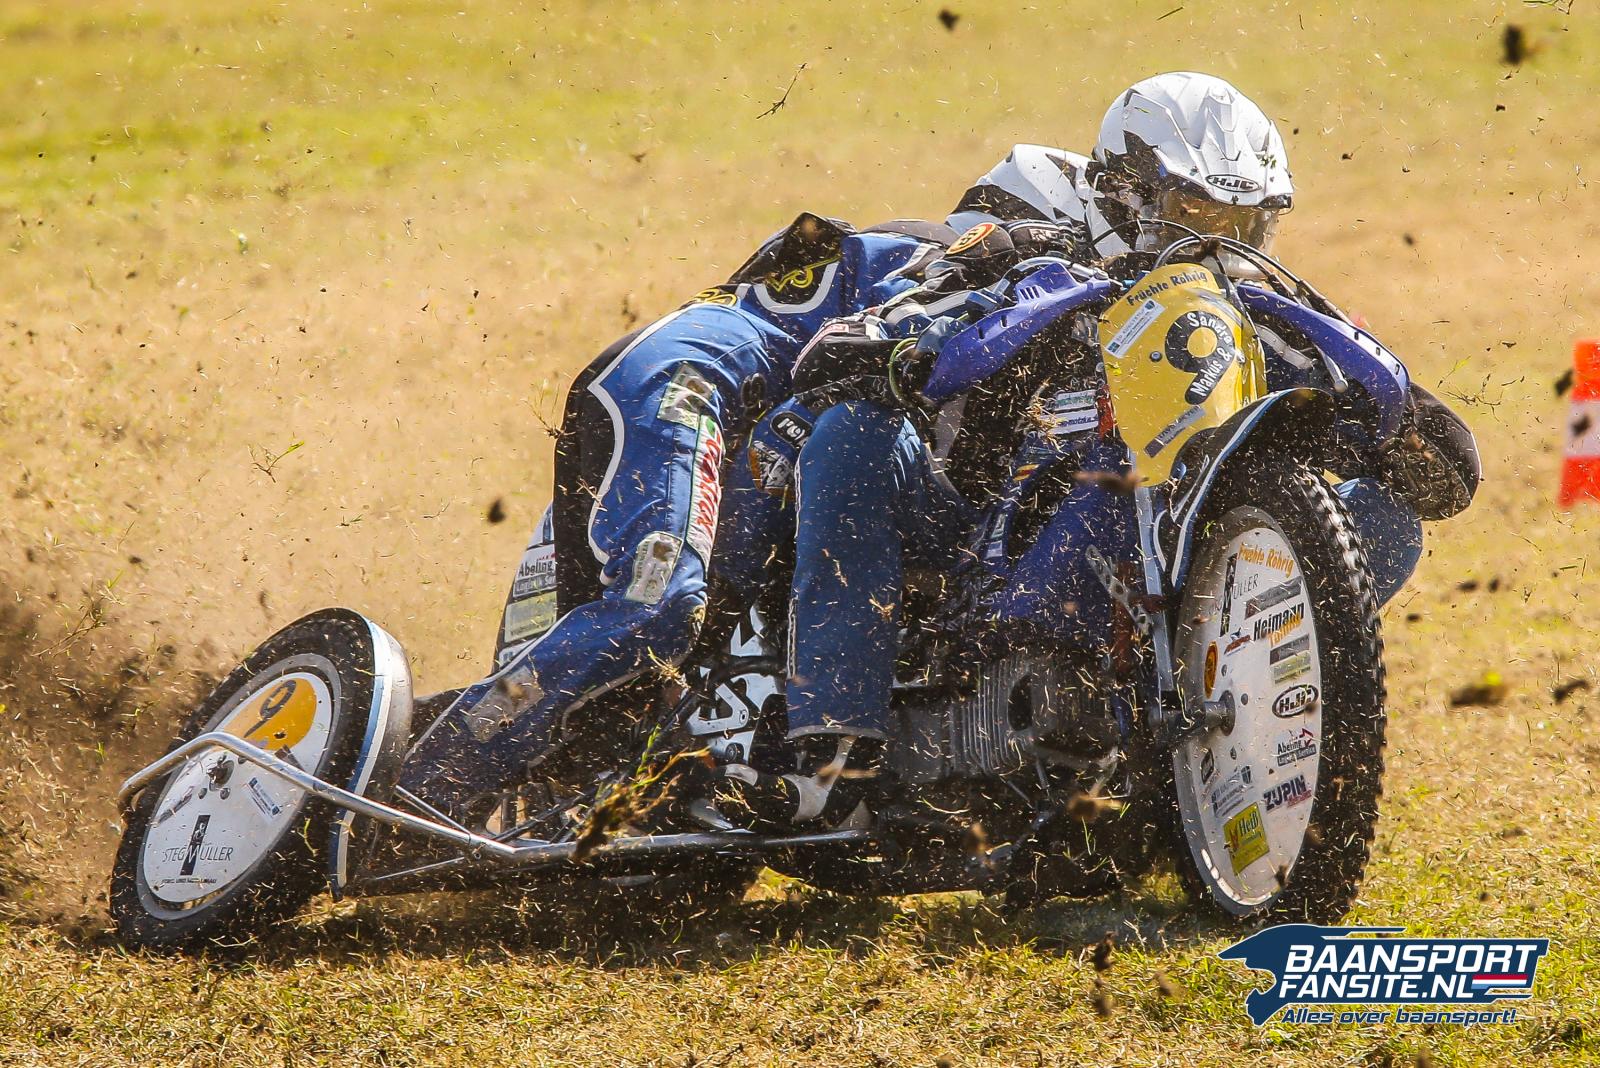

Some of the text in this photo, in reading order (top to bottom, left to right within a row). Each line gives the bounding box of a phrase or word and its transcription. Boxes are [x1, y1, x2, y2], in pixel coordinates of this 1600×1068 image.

[1212, 176, 1255, 189] HJC
[1126, 270, 1208, 306] Früchte Röhrig
[1186, 311, 1234, 345] Sandra
[1164, 310, 1236, 405] 9
[1189, 358, 1224, 397] Markus
[518, 560, 555, 578] Abeling
[1253, 602, 1305, 642] Heimann
[1263, 774, 1307, 812] ZUPIN
